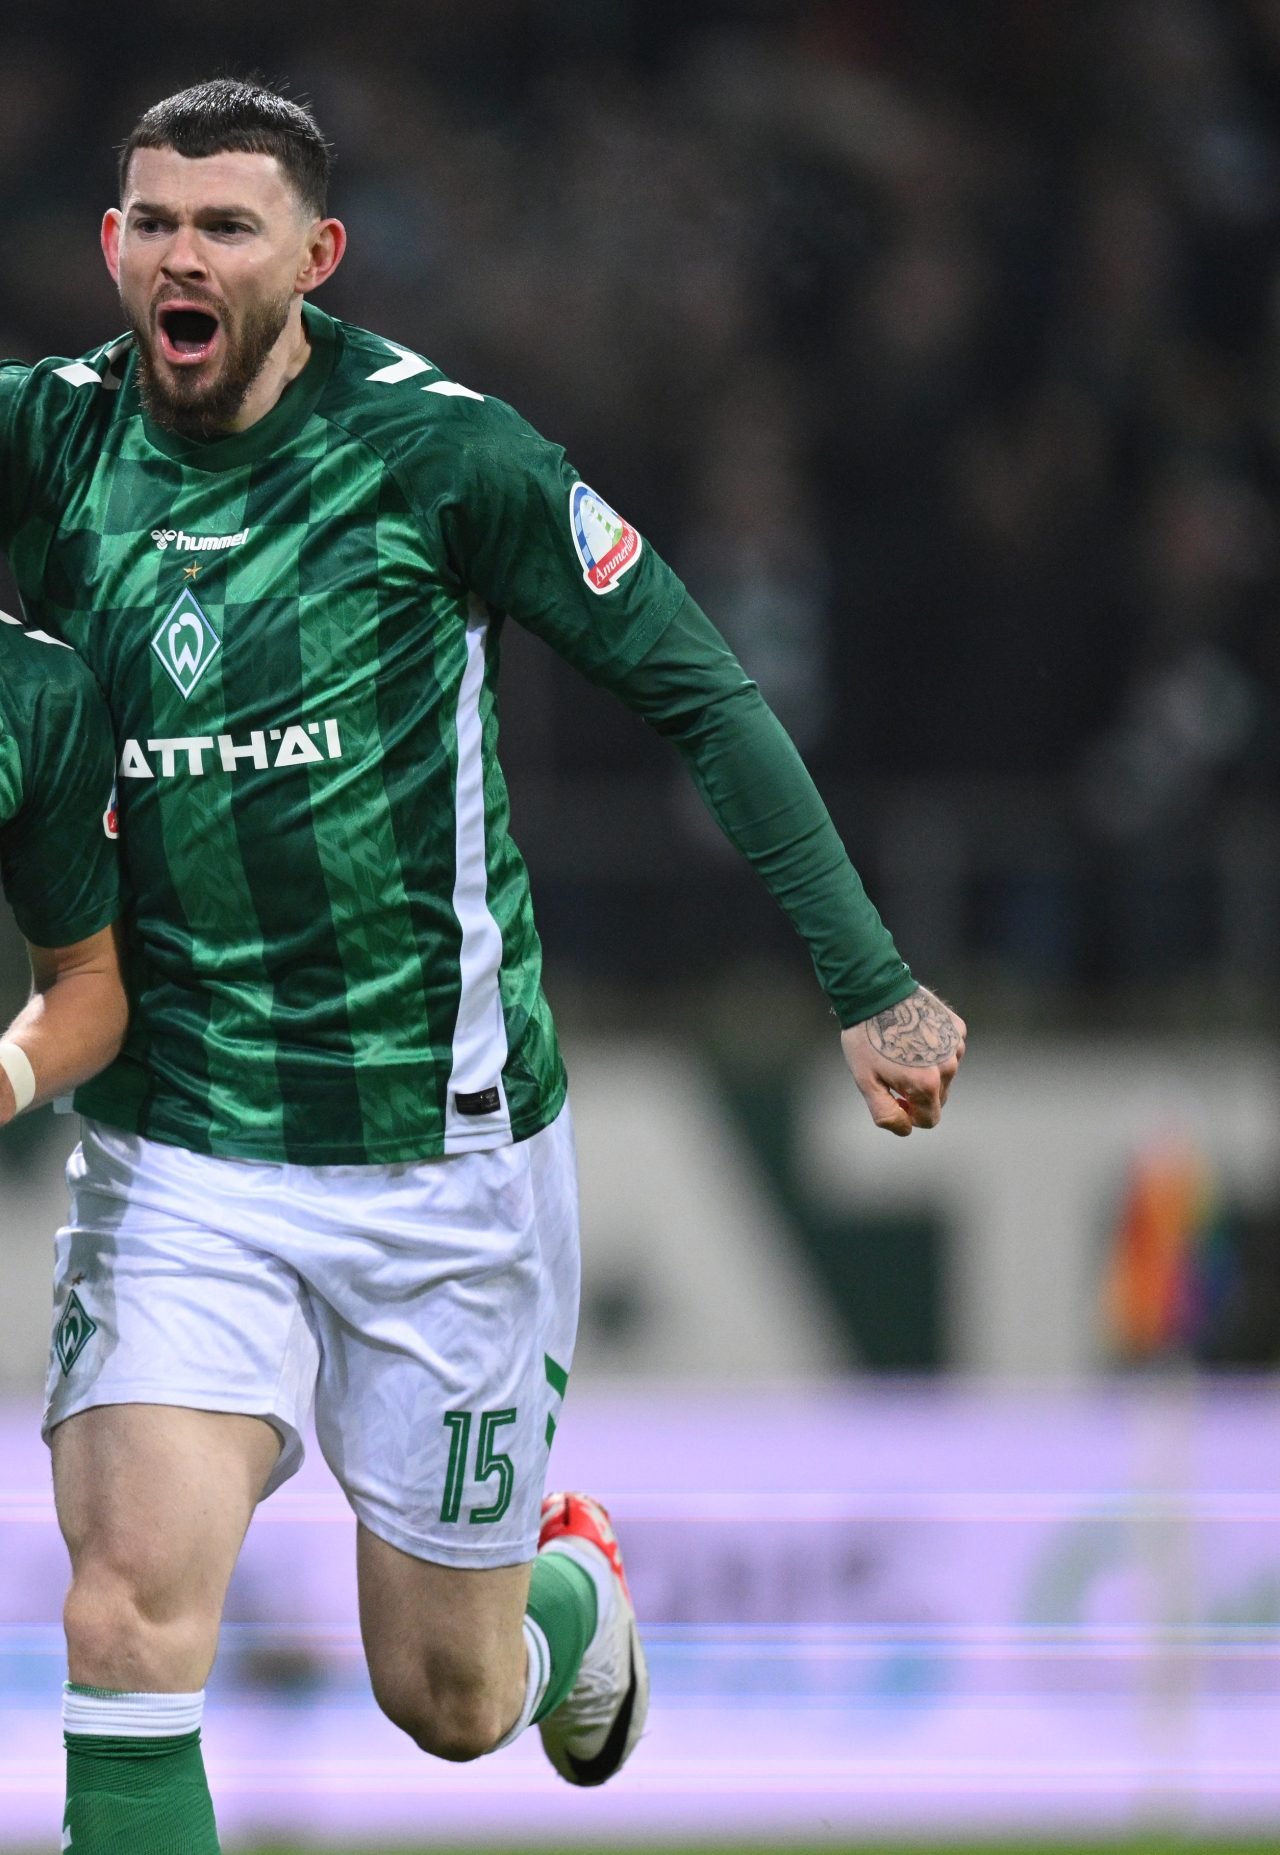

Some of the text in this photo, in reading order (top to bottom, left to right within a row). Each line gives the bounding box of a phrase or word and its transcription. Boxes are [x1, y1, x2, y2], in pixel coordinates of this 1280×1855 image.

[176, 528, 250, 550] hummel
[118, 718, 342, 778] ATTHÄI
[439, 1407, 517, 1525] 15
